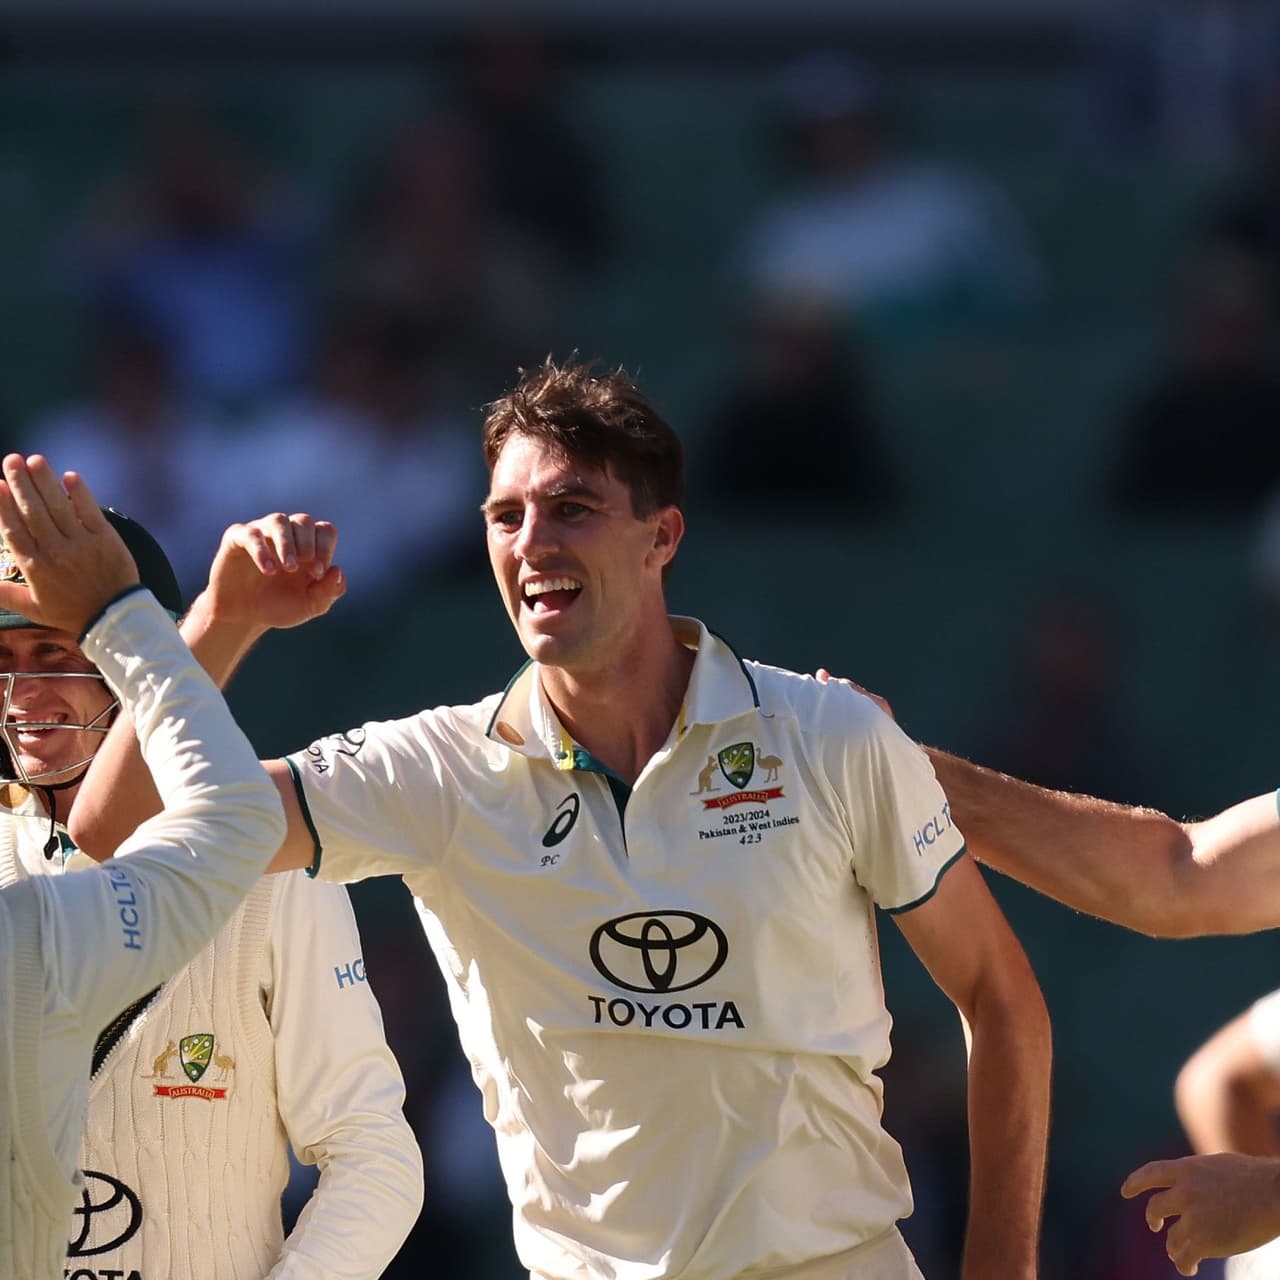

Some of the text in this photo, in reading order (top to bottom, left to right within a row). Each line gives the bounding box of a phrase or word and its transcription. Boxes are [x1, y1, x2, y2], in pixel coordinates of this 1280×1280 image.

[698, 816, 800, 840] Pakistan & West Indies
[723, 810, 770, 825] 2023/2024
[739, 833, 762, 845] 423
[913, 803, 951, 857] HCLT
[587, 995, 745, 1030] TOYOTA
